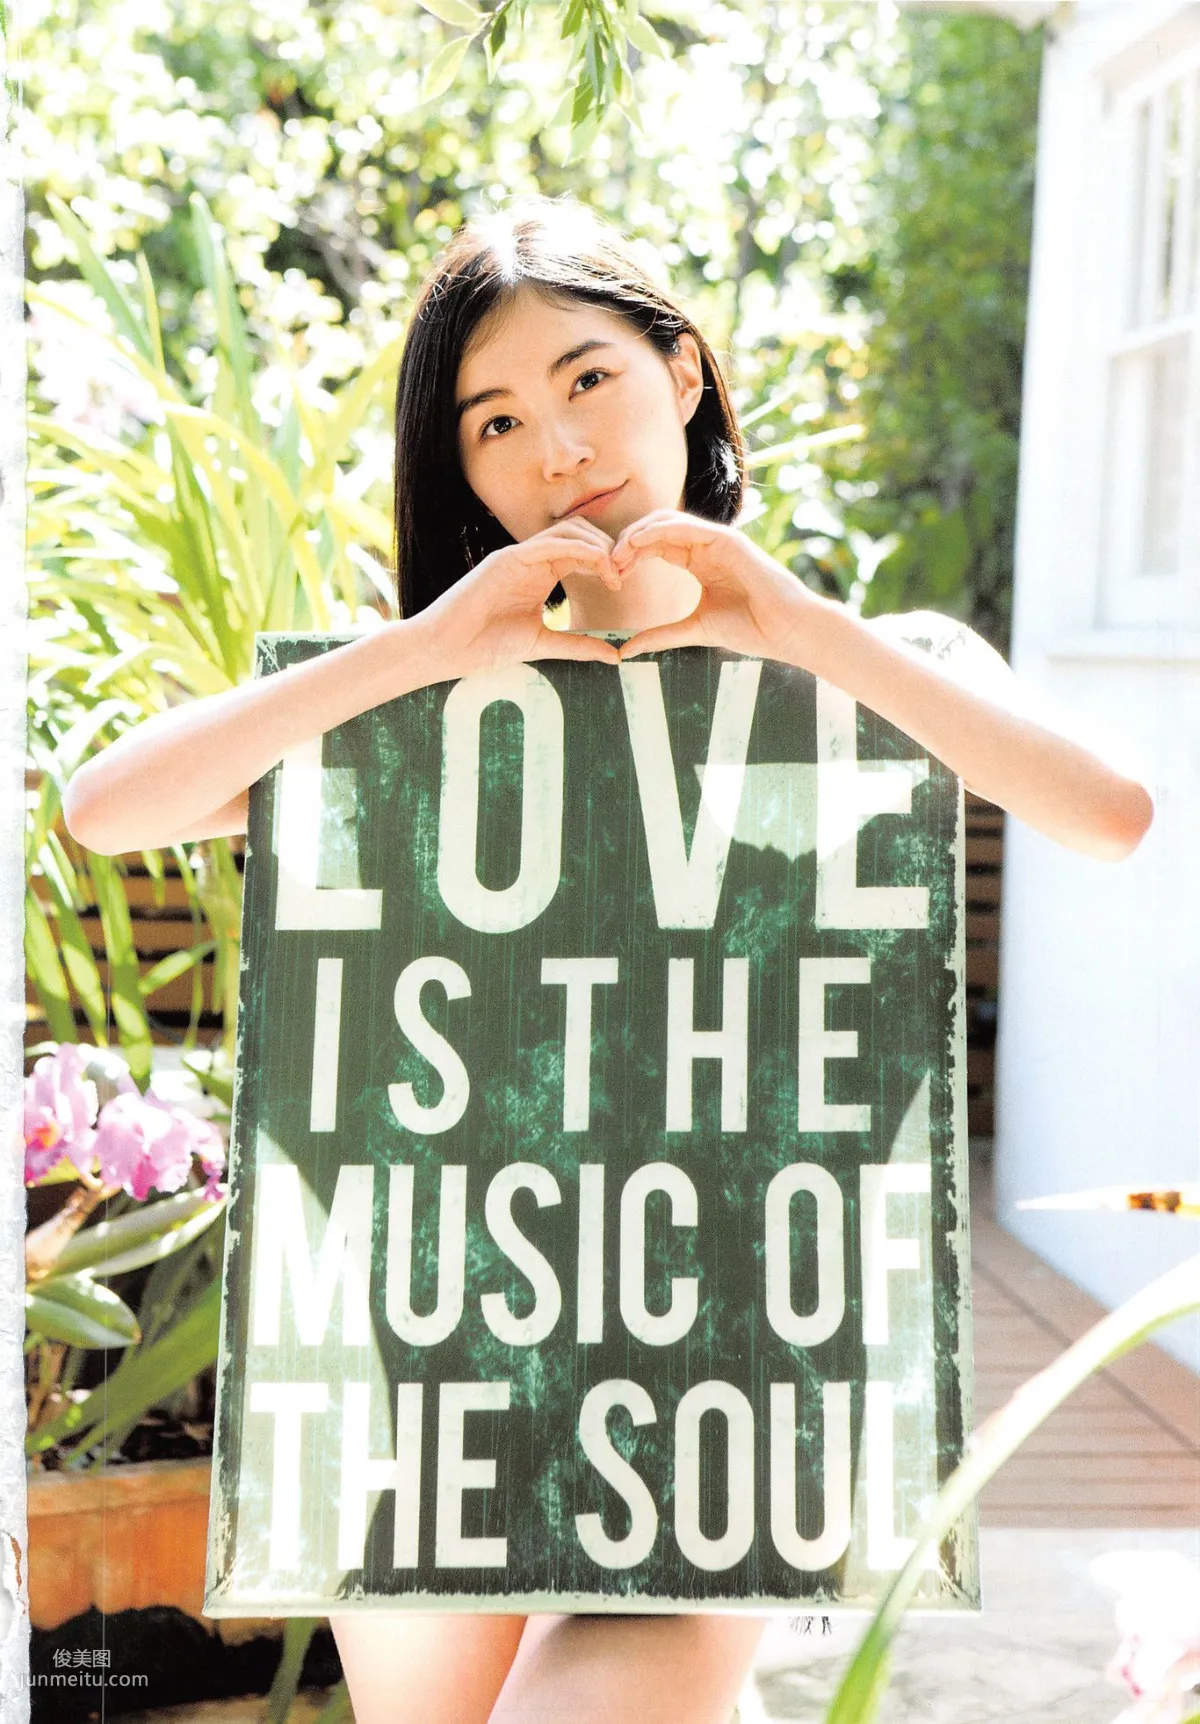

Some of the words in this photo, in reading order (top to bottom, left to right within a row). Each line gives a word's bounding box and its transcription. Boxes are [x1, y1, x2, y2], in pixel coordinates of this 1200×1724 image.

[274, 661, 930, 934] LOVE
[309, 956, 472, 1135] IS
[541, 957, 872, 1133] THE
[252, 1162, 699, 1347] MUSIC
[764, 1162, 931, 1347] OF
[248, 1381, 510, 1571] THE
[575, 1378, 938, 1572] SOUL
